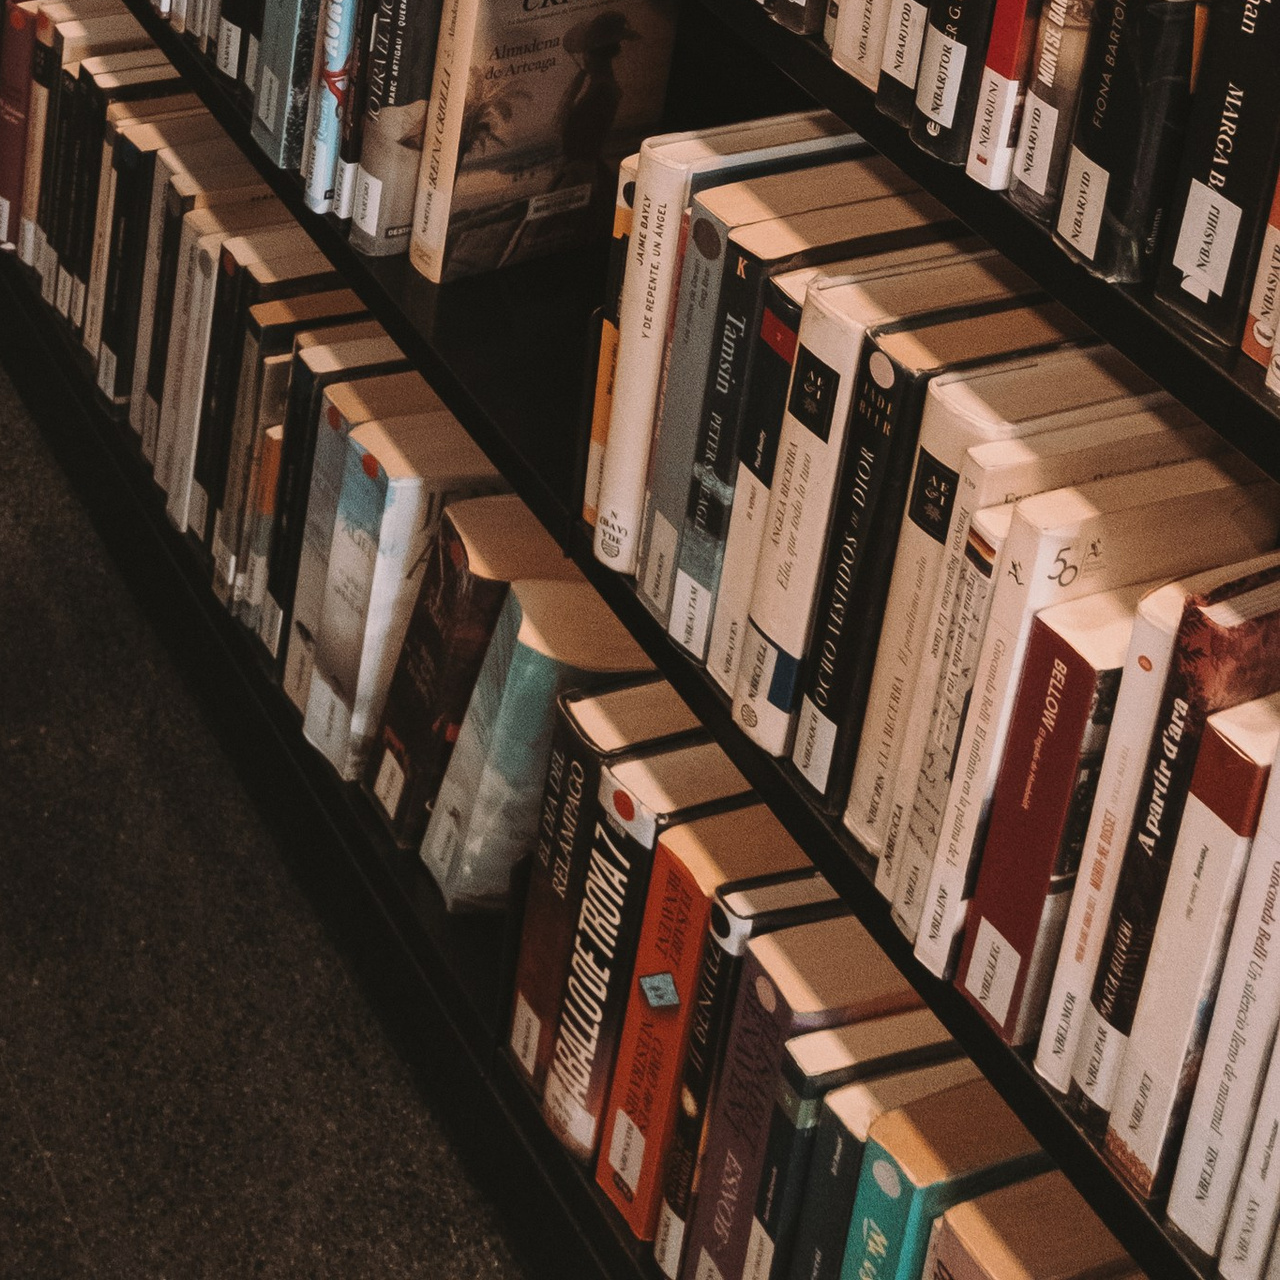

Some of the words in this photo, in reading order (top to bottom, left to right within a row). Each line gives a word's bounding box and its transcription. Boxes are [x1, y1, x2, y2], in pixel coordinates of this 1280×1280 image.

[488, 35, 561, 61] Almudena
[892, 2, 913, 73] N(BAR)TOD
[929, 43, 953, 115] N(BAR)TOR
[1092, 72, 1112, 130] FIONA
[977, 80, 999, 149] N(BAR)UNI
[1022, 106, 1043, 175] N(BAR)VID
[1211, 82, 1246, 180] MARGA
[638, 193, 653, 230] BAYLY
[651, 202, 668, 240] ÁNGEL
[1070, 170, 1092, 241] N(BAR)VID
[1193, 204, 1222, 271] N(BAS)HIJ
[634, 230, 649, 267] JAIME
[650, 240, 663, 258] UN
[643, 260, 661, 313] REPENTE,
[640, 331, 651, 340] Y
[642, 314, 654, 330] DE
[715, 311, 747, 395] Tamsin
[813, 638, 839, 708] OCHO
[826, 530, 861, 635] VESTIDOS
[849, 444, 876, 508] DIOR
[881, 675, 906, 738] BECERRA
[1040, 657, 1068, 733] BELLOW
[927, 884, 950, 942] N(BEL)INF
[978, 941, 1002, 1003] N(BEL)LEG
[1051, 991, 1077, 1059] N(BEL)MOR
[1084, 1026, 1109, 1092] N(BEL)PAR
[1128, 1069, 1154, 1134] N(BEL)PET
